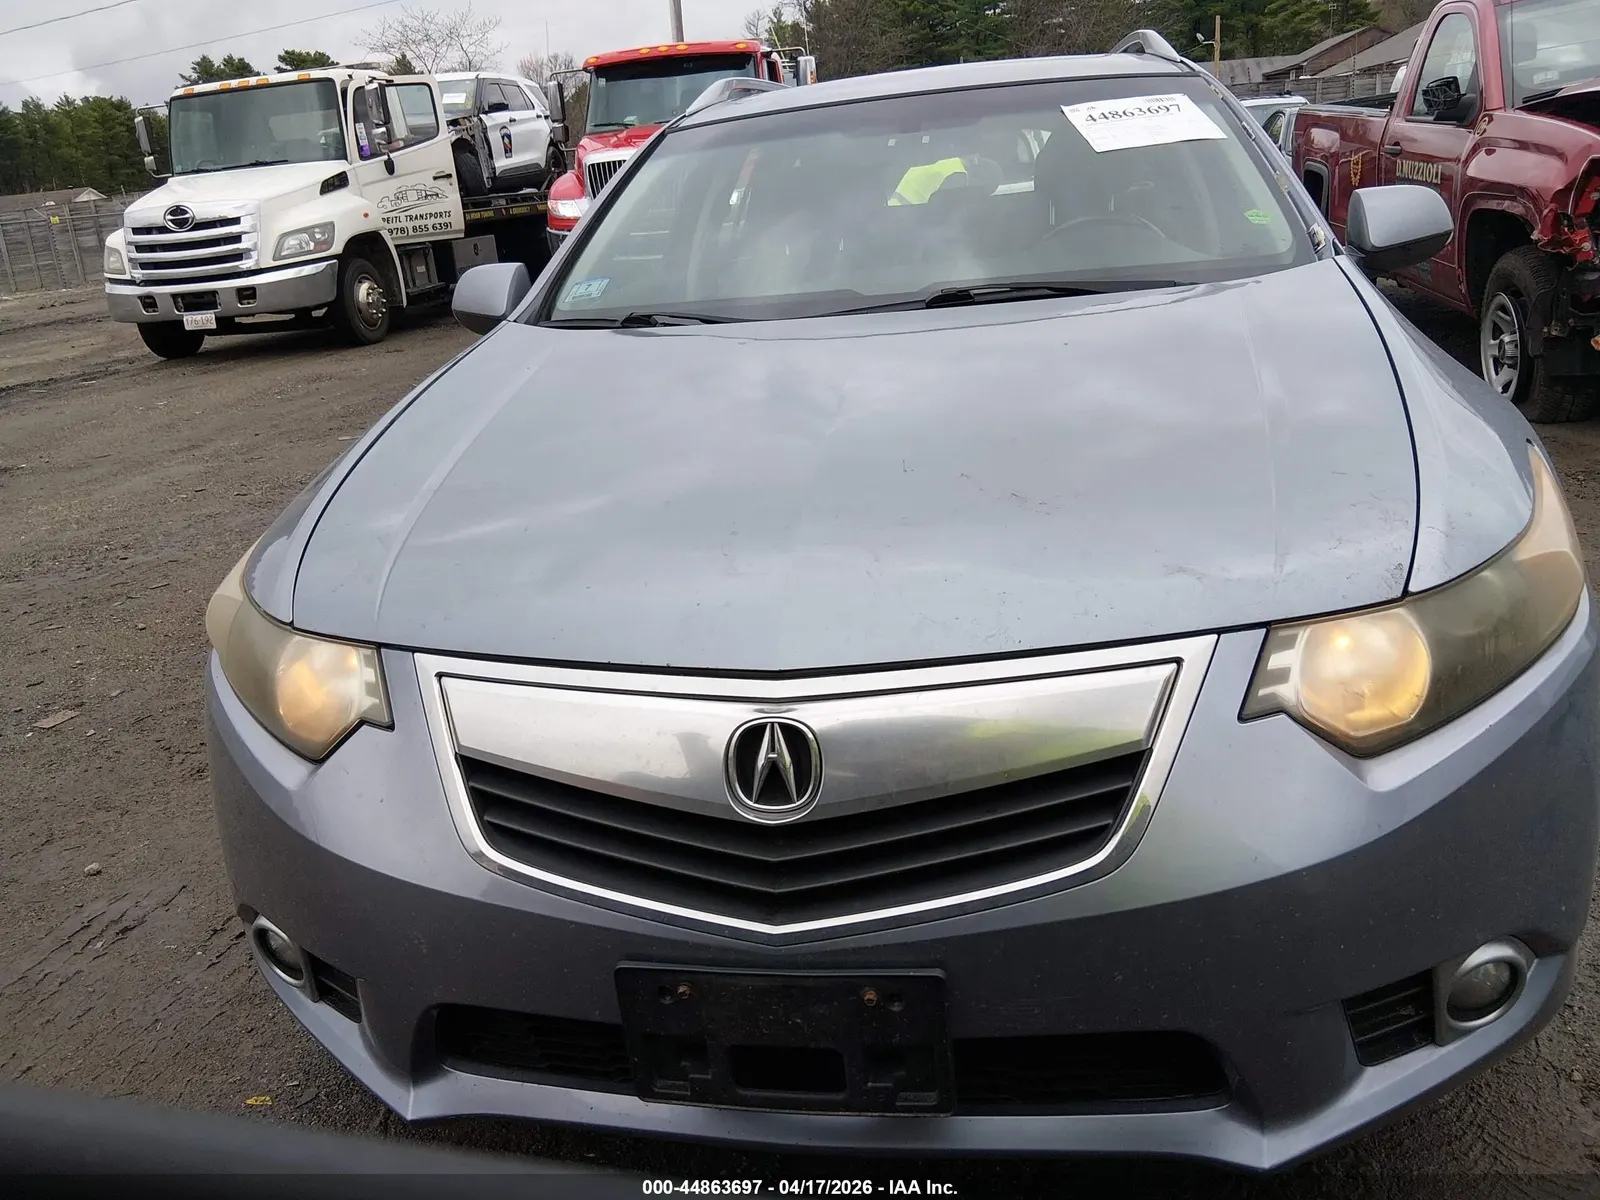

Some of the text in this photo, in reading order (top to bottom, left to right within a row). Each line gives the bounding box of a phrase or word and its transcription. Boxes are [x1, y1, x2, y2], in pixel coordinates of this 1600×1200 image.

[1085, 104, 1181, 122] 44863697
[405, 210, 452, 222] TRANSPORTS
[412, 224, 430, 233] 855
[432, 221, 453, 231] 6391
